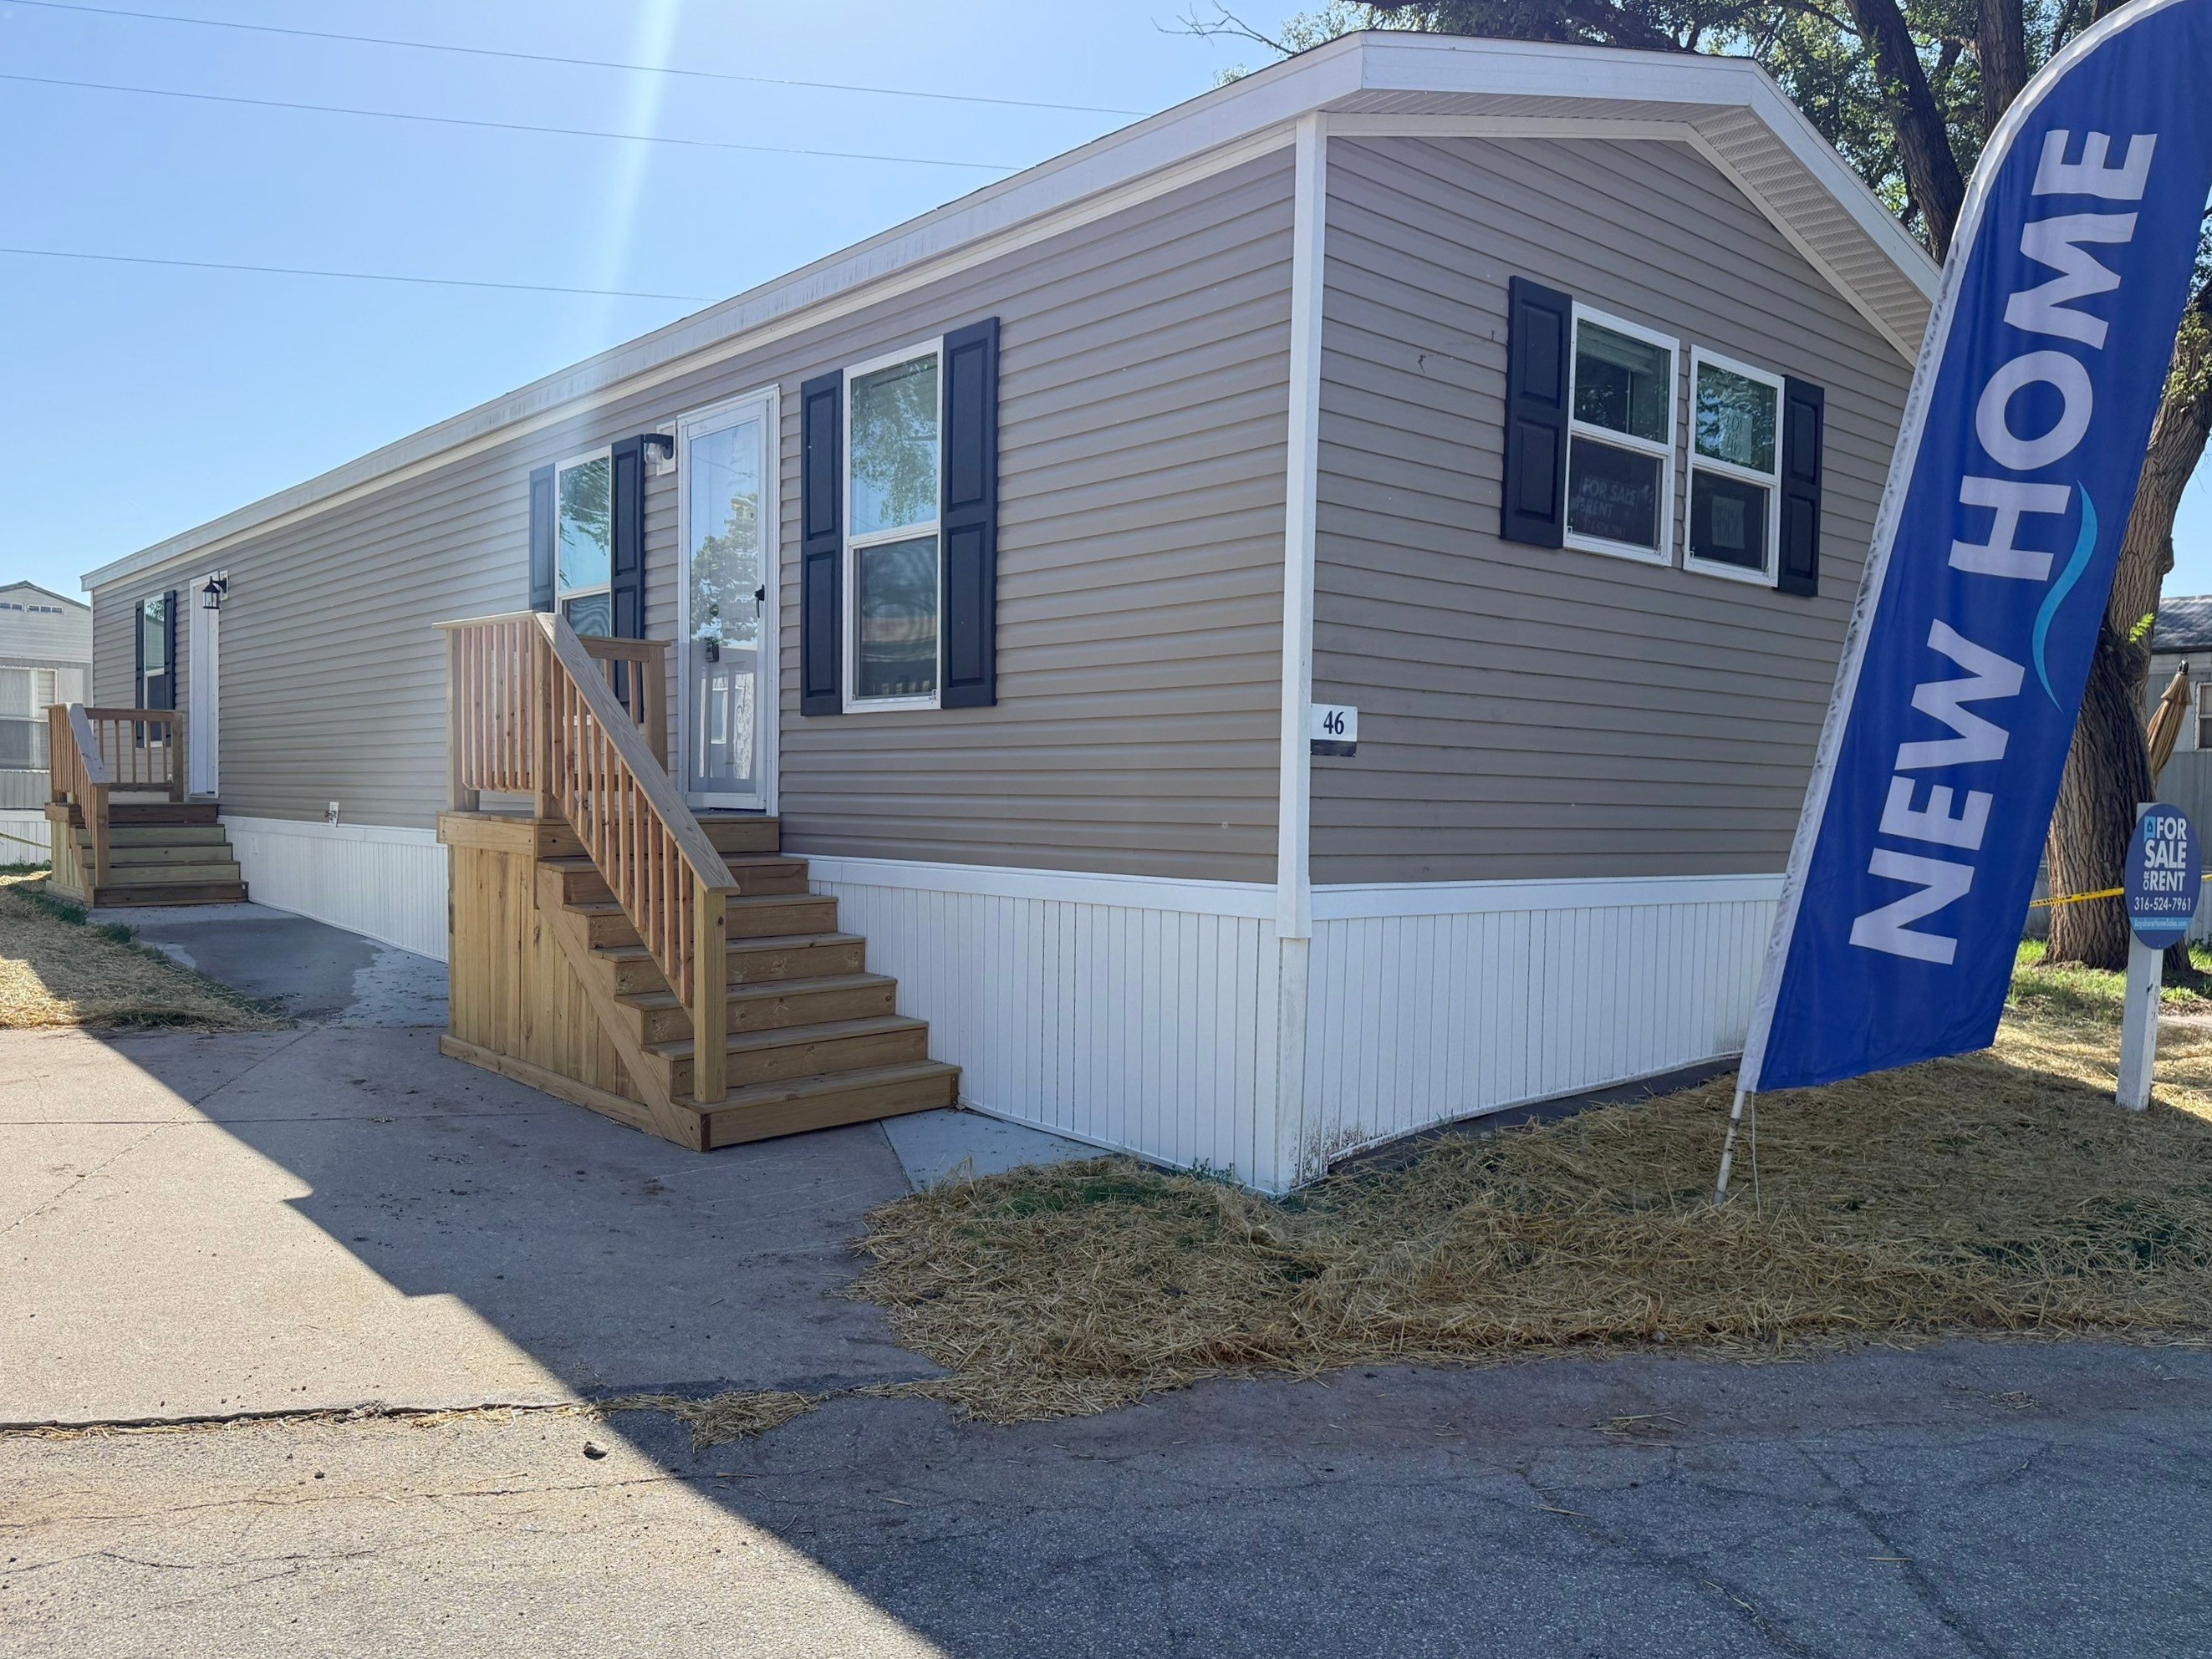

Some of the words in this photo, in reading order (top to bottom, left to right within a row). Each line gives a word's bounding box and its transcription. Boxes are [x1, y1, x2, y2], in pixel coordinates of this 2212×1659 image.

[1583, 477, 1607, 499] FOR
[1611, 485, 1637, 506] SALE
[1585, 498, 1614, 518] RENT
[1849, 618, 2026, 965] NEW
[1948, 130, 2158, 581] HOME
[1323, 710, 1344, 735] 46
[2156, 817, 2187, 840] FOR
[2144, 839, 2188, 869] SALE
[2143, 871, 2150, 891] OR
[2149, 871, 2185, 892] RENT
[2134, 897, 2191, 911] 316-524-7961
